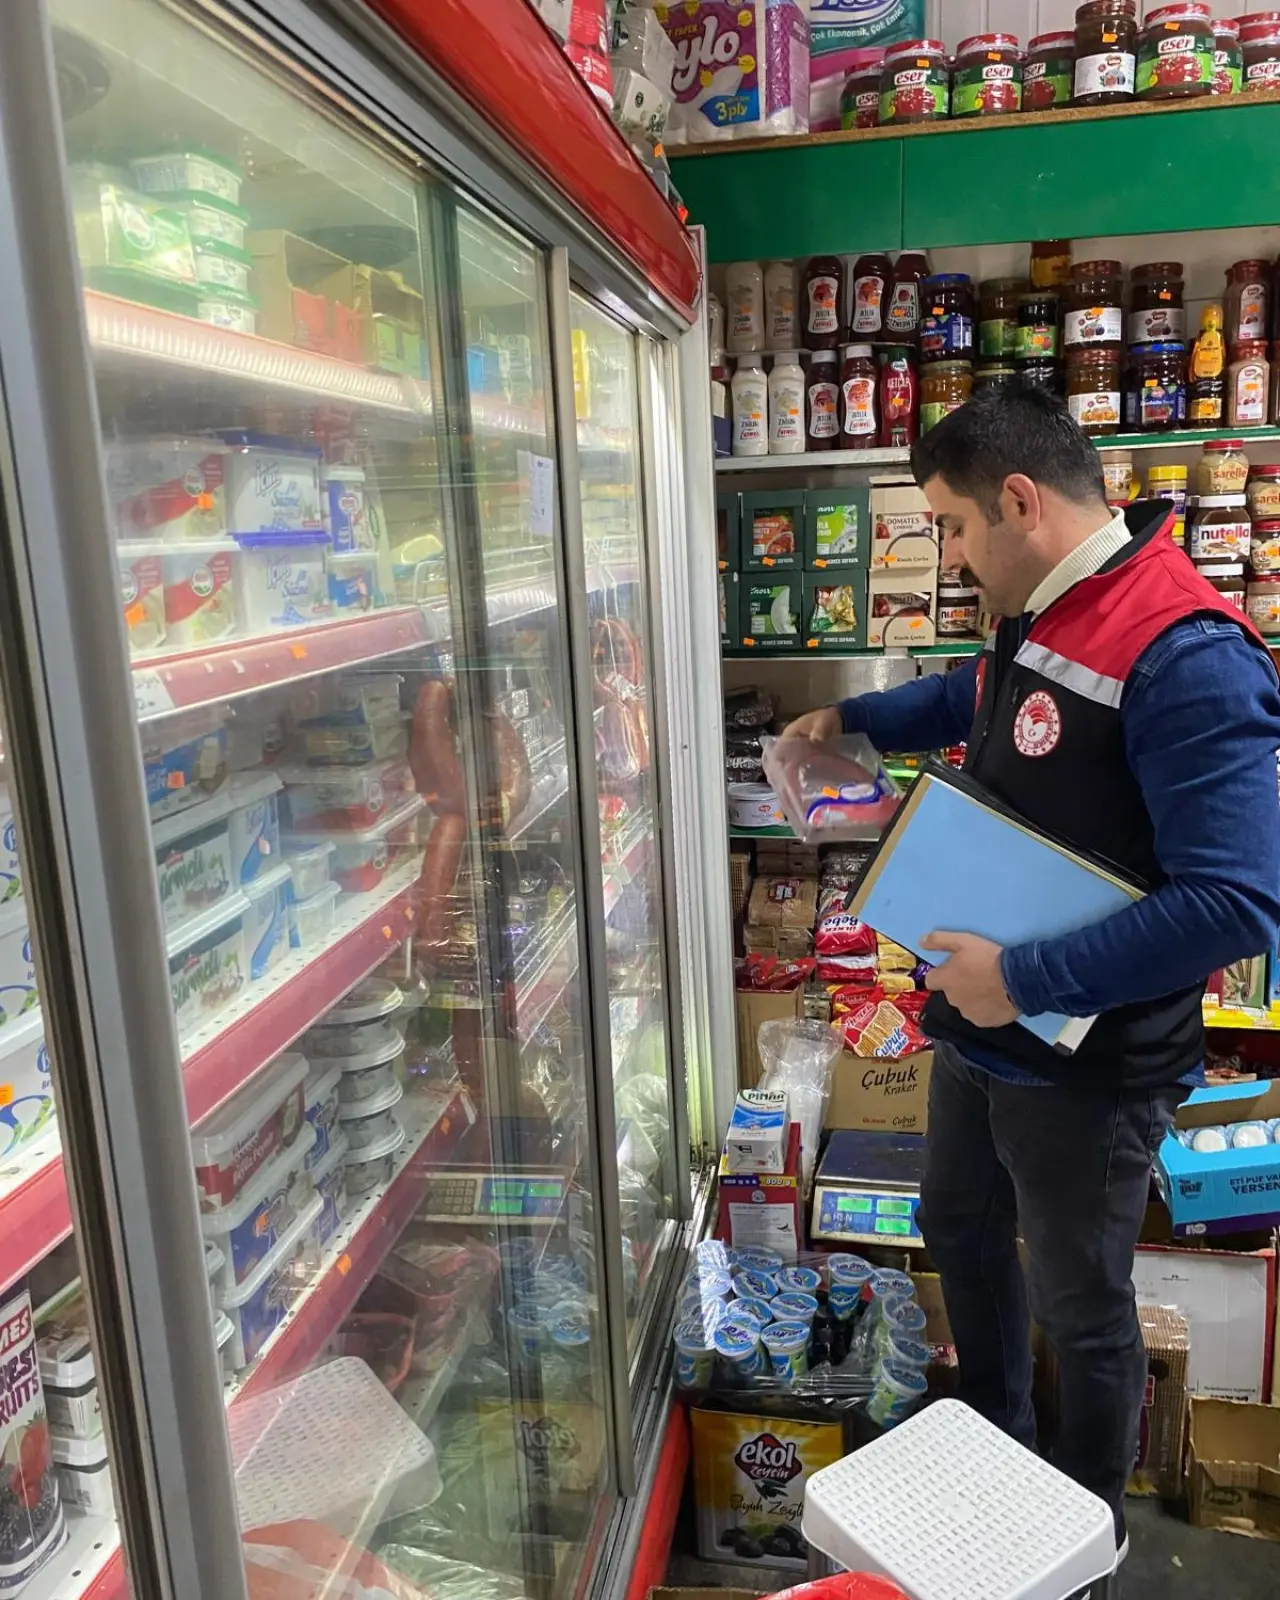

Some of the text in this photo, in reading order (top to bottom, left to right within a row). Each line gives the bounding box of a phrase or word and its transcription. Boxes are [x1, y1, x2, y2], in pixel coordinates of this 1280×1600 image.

[1160, 38, 1191, 52] eser
[896, 70, 922, 84] eser
[985, 65, 1012, 77] eser
[858, 93, 879, 105] ese
[1213, 469, 1247, 479] sarelle
[886, 516, 920, 525] DOMATES
[824, 914, 858, 926] Bebe
[861, 1065, 919, 1090] Çubuk
[883, 1082, 918, 1096] Kraker
[740, 1440, 795, 1469] ekol
[749, 1464, 790, 1479] Zeytin
[767, 1500, 806, 1522] Zeyt
